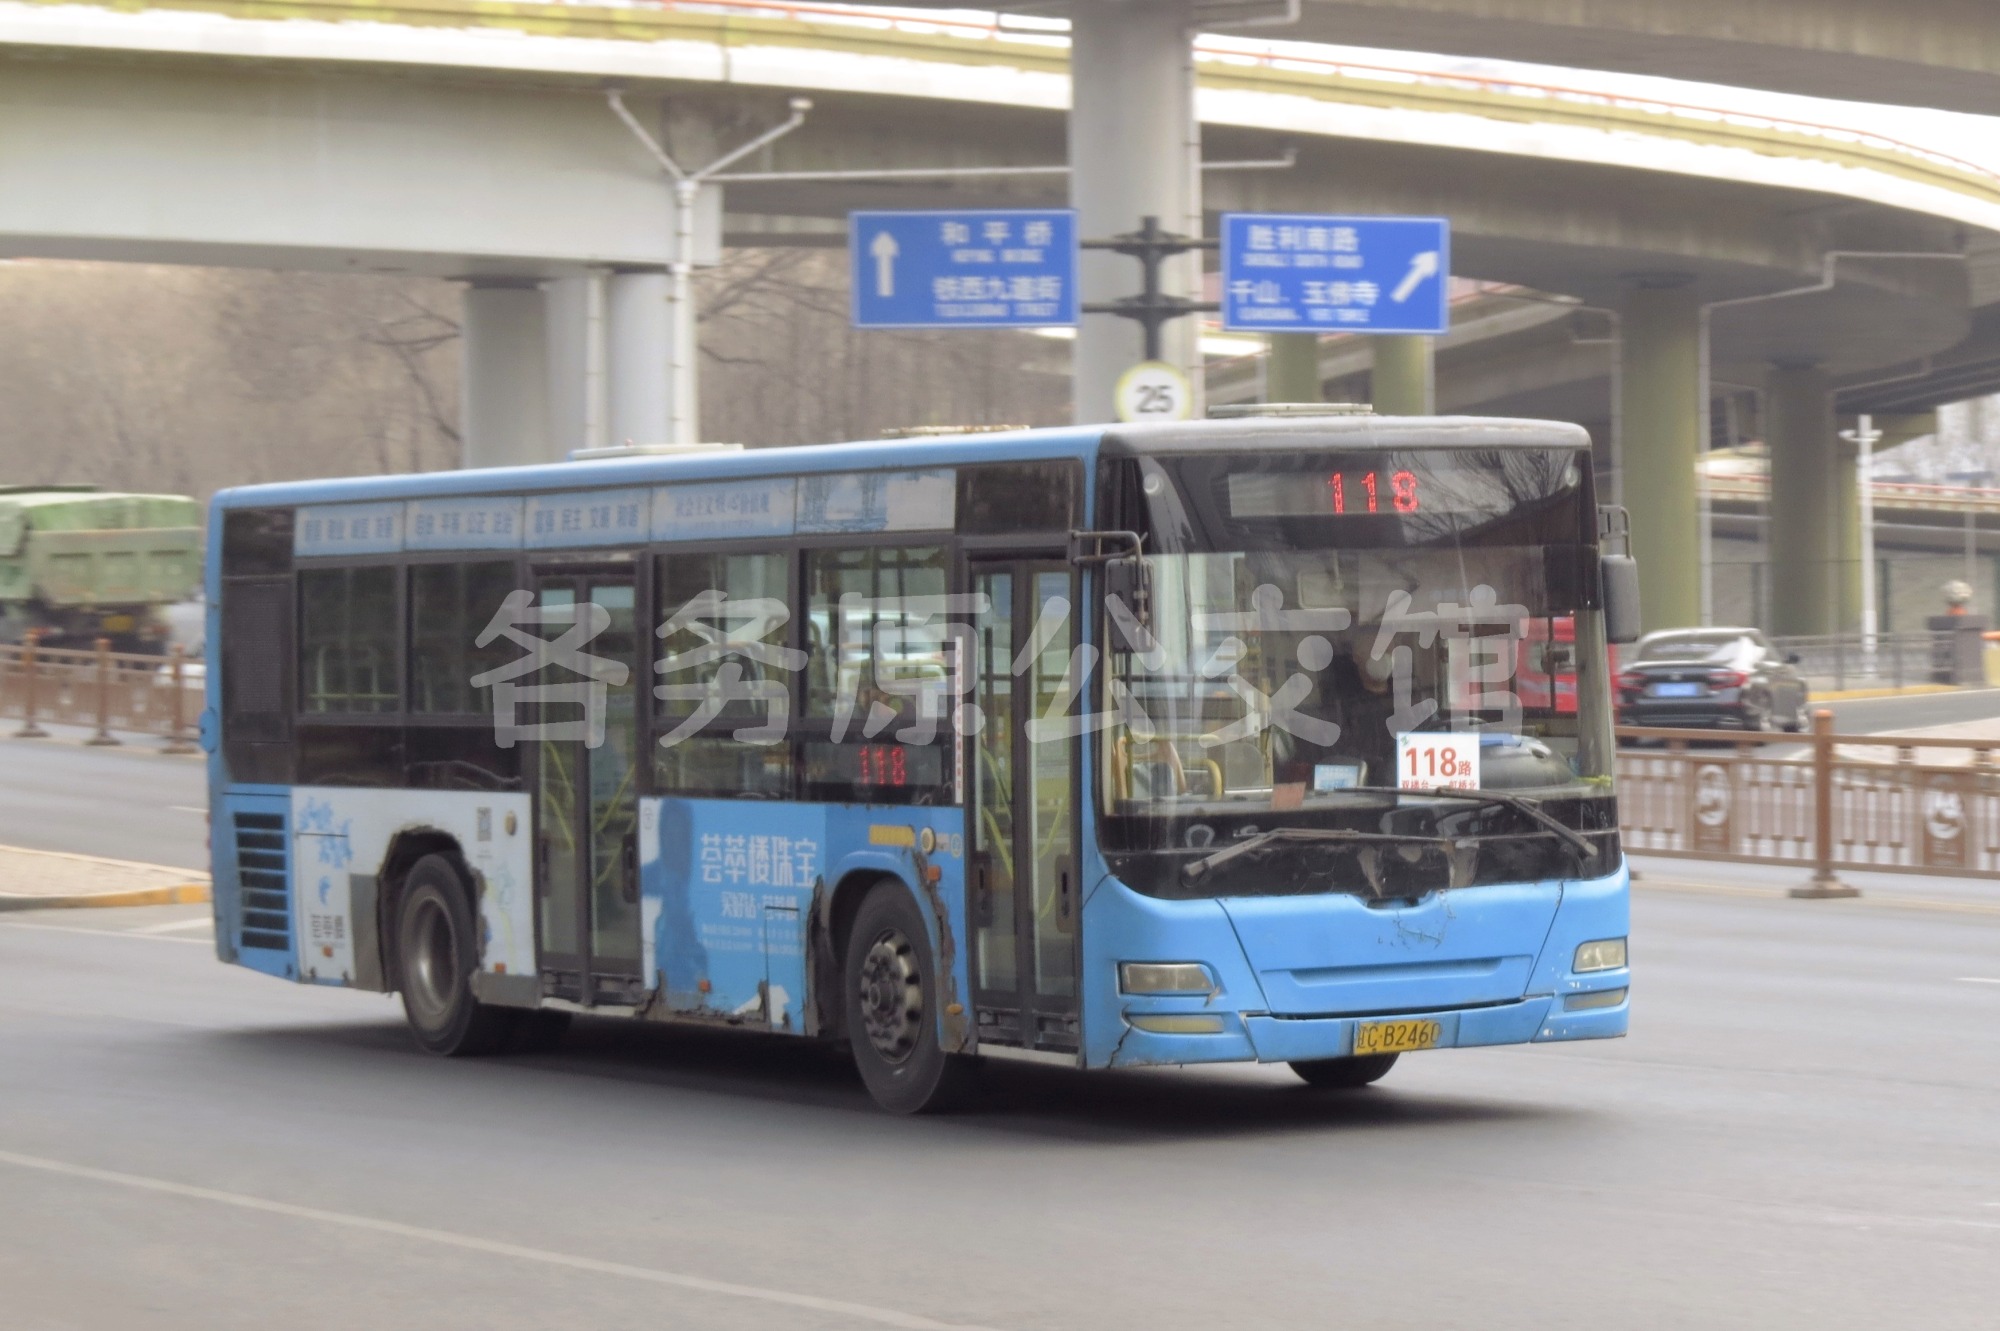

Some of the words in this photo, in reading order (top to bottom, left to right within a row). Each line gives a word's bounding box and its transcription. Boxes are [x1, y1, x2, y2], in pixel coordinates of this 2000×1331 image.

[1135, 385, 1174, 413] 25
[1328, 471, 1418, 514] 118
[859, 745, 906, 786] 118
[1406, 747, 1472, 777] 118路
[700, 833, 817, 888] 荟萃楼珠宝
